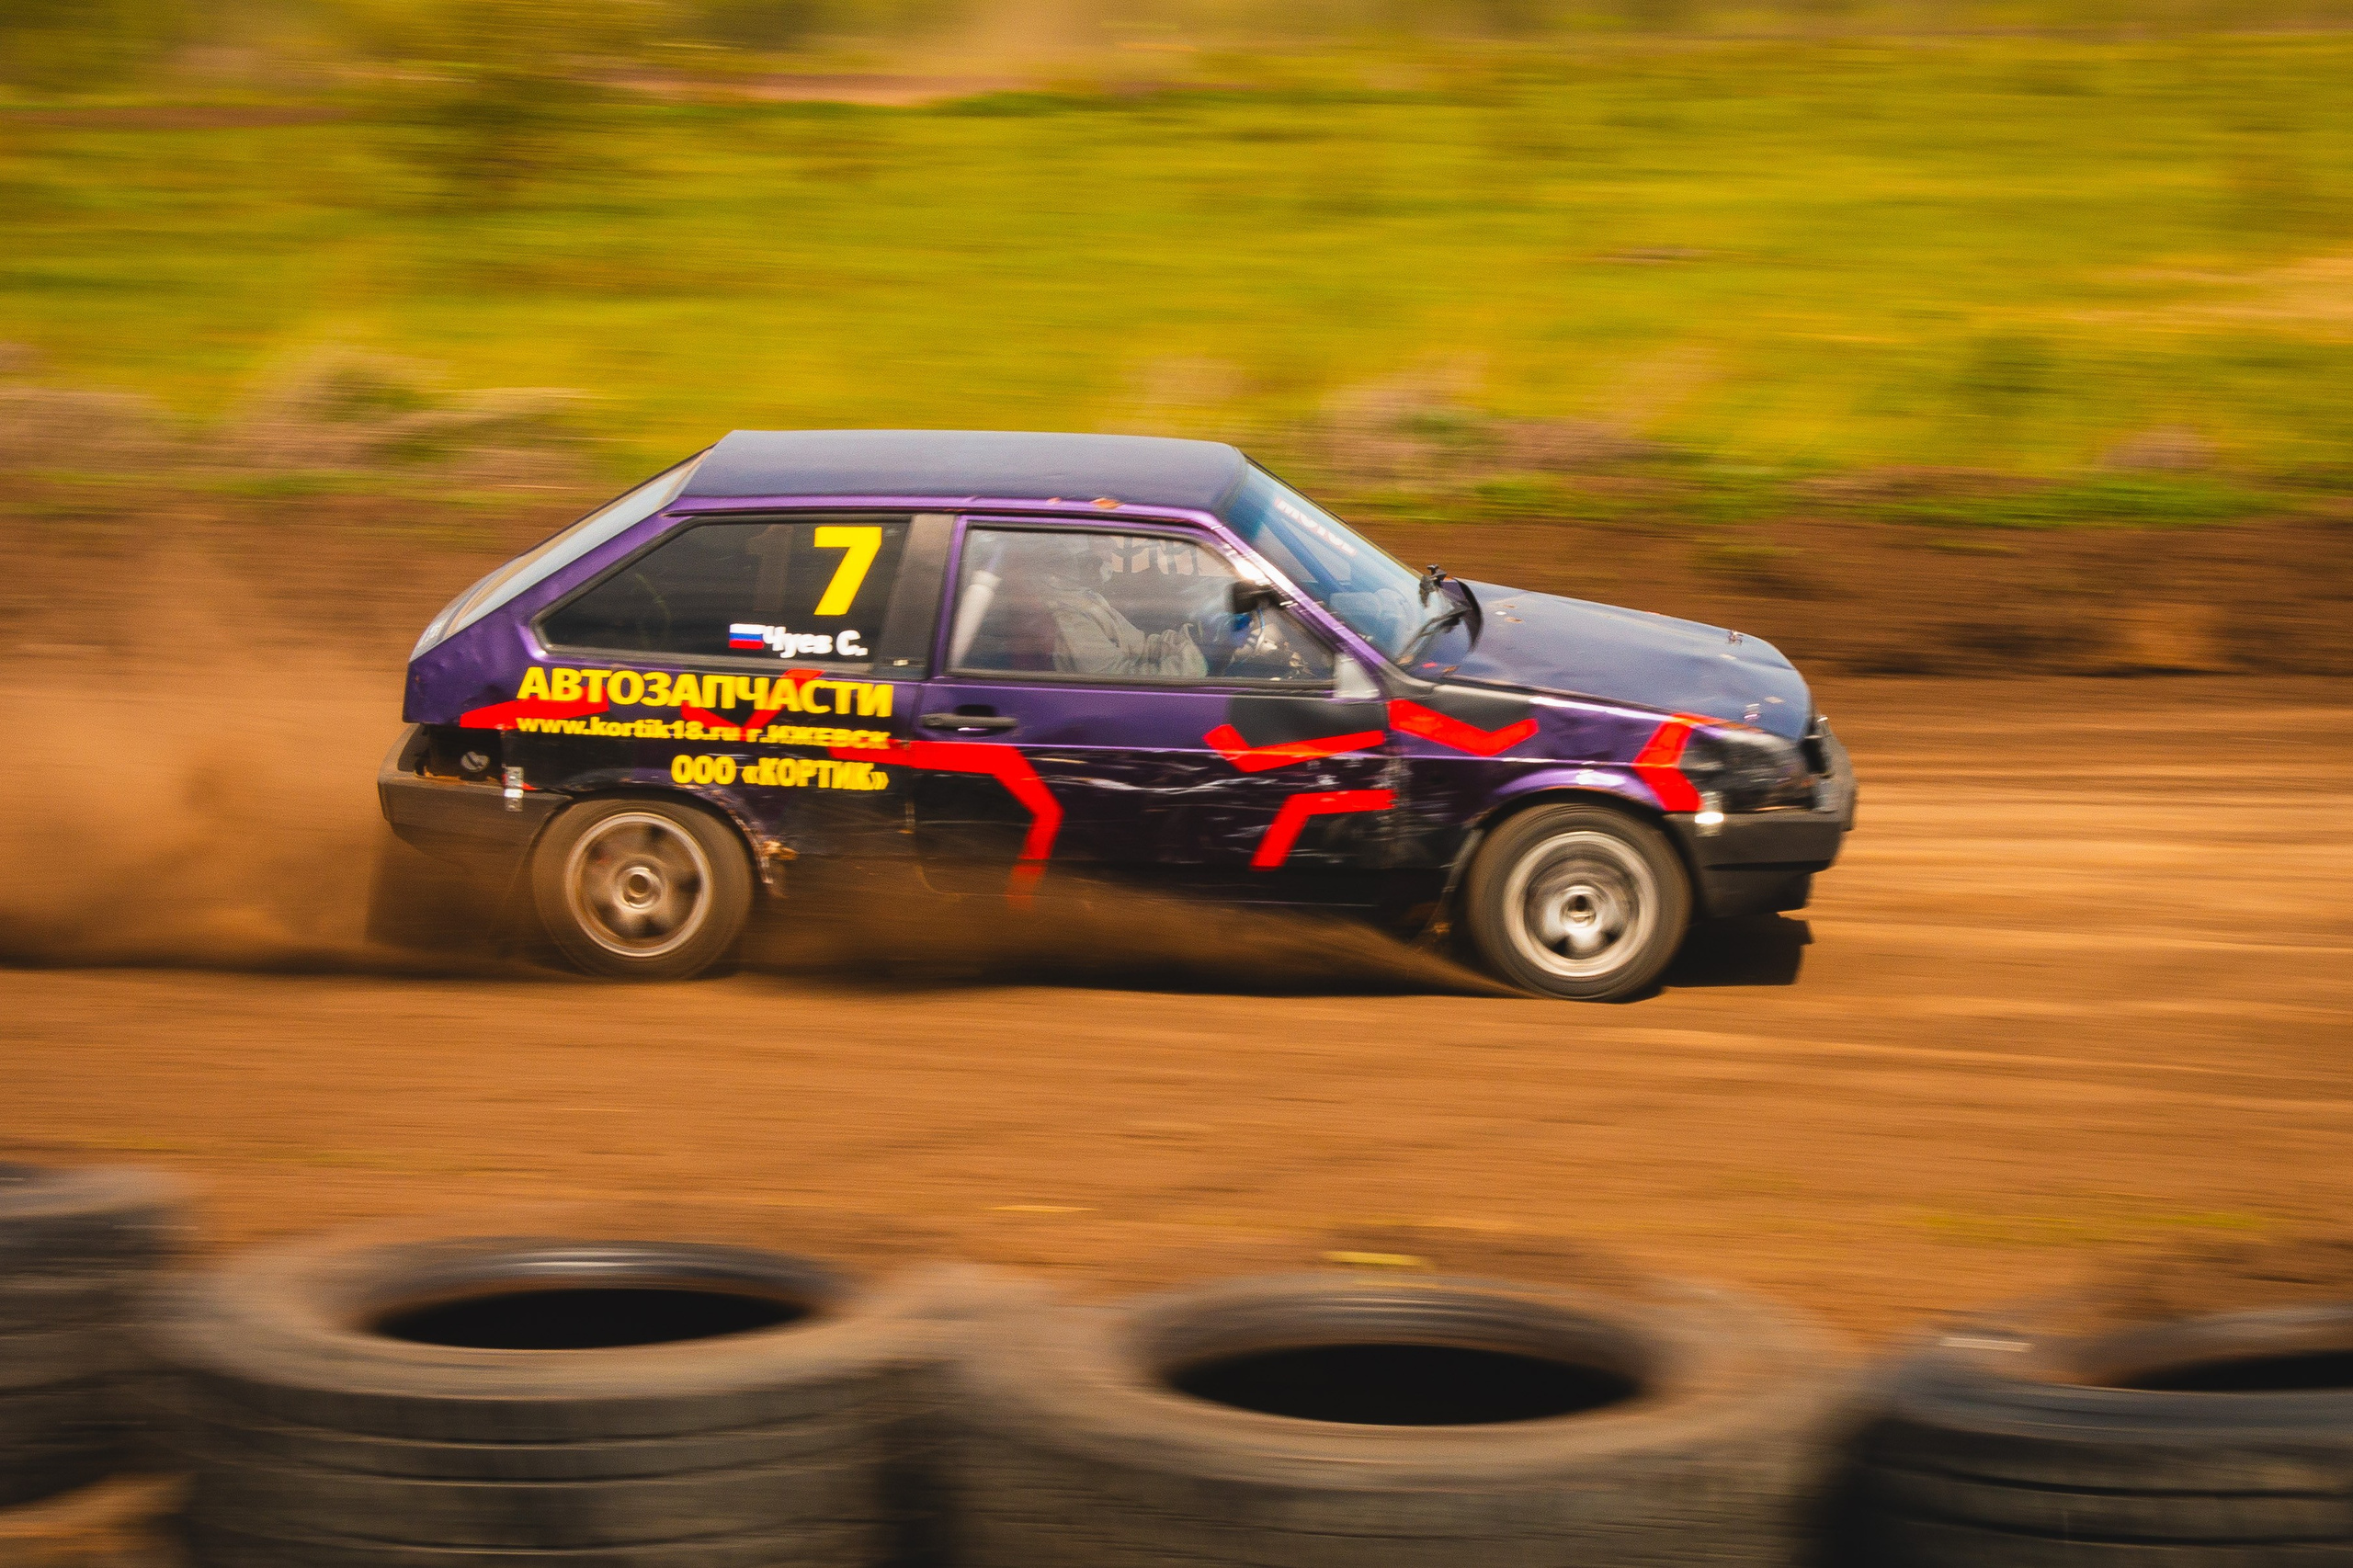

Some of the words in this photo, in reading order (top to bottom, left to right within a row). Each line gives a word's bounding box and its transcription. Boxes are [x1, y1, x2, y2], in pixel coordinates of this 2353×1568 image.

[813, 526, 882, 616] 7
[517, 666, 893, 718] АВТОЗАПЧАСТИ
[516, 716, 741, 742] www.kortik18.ru
[670, 755, 736, 785] ООО
